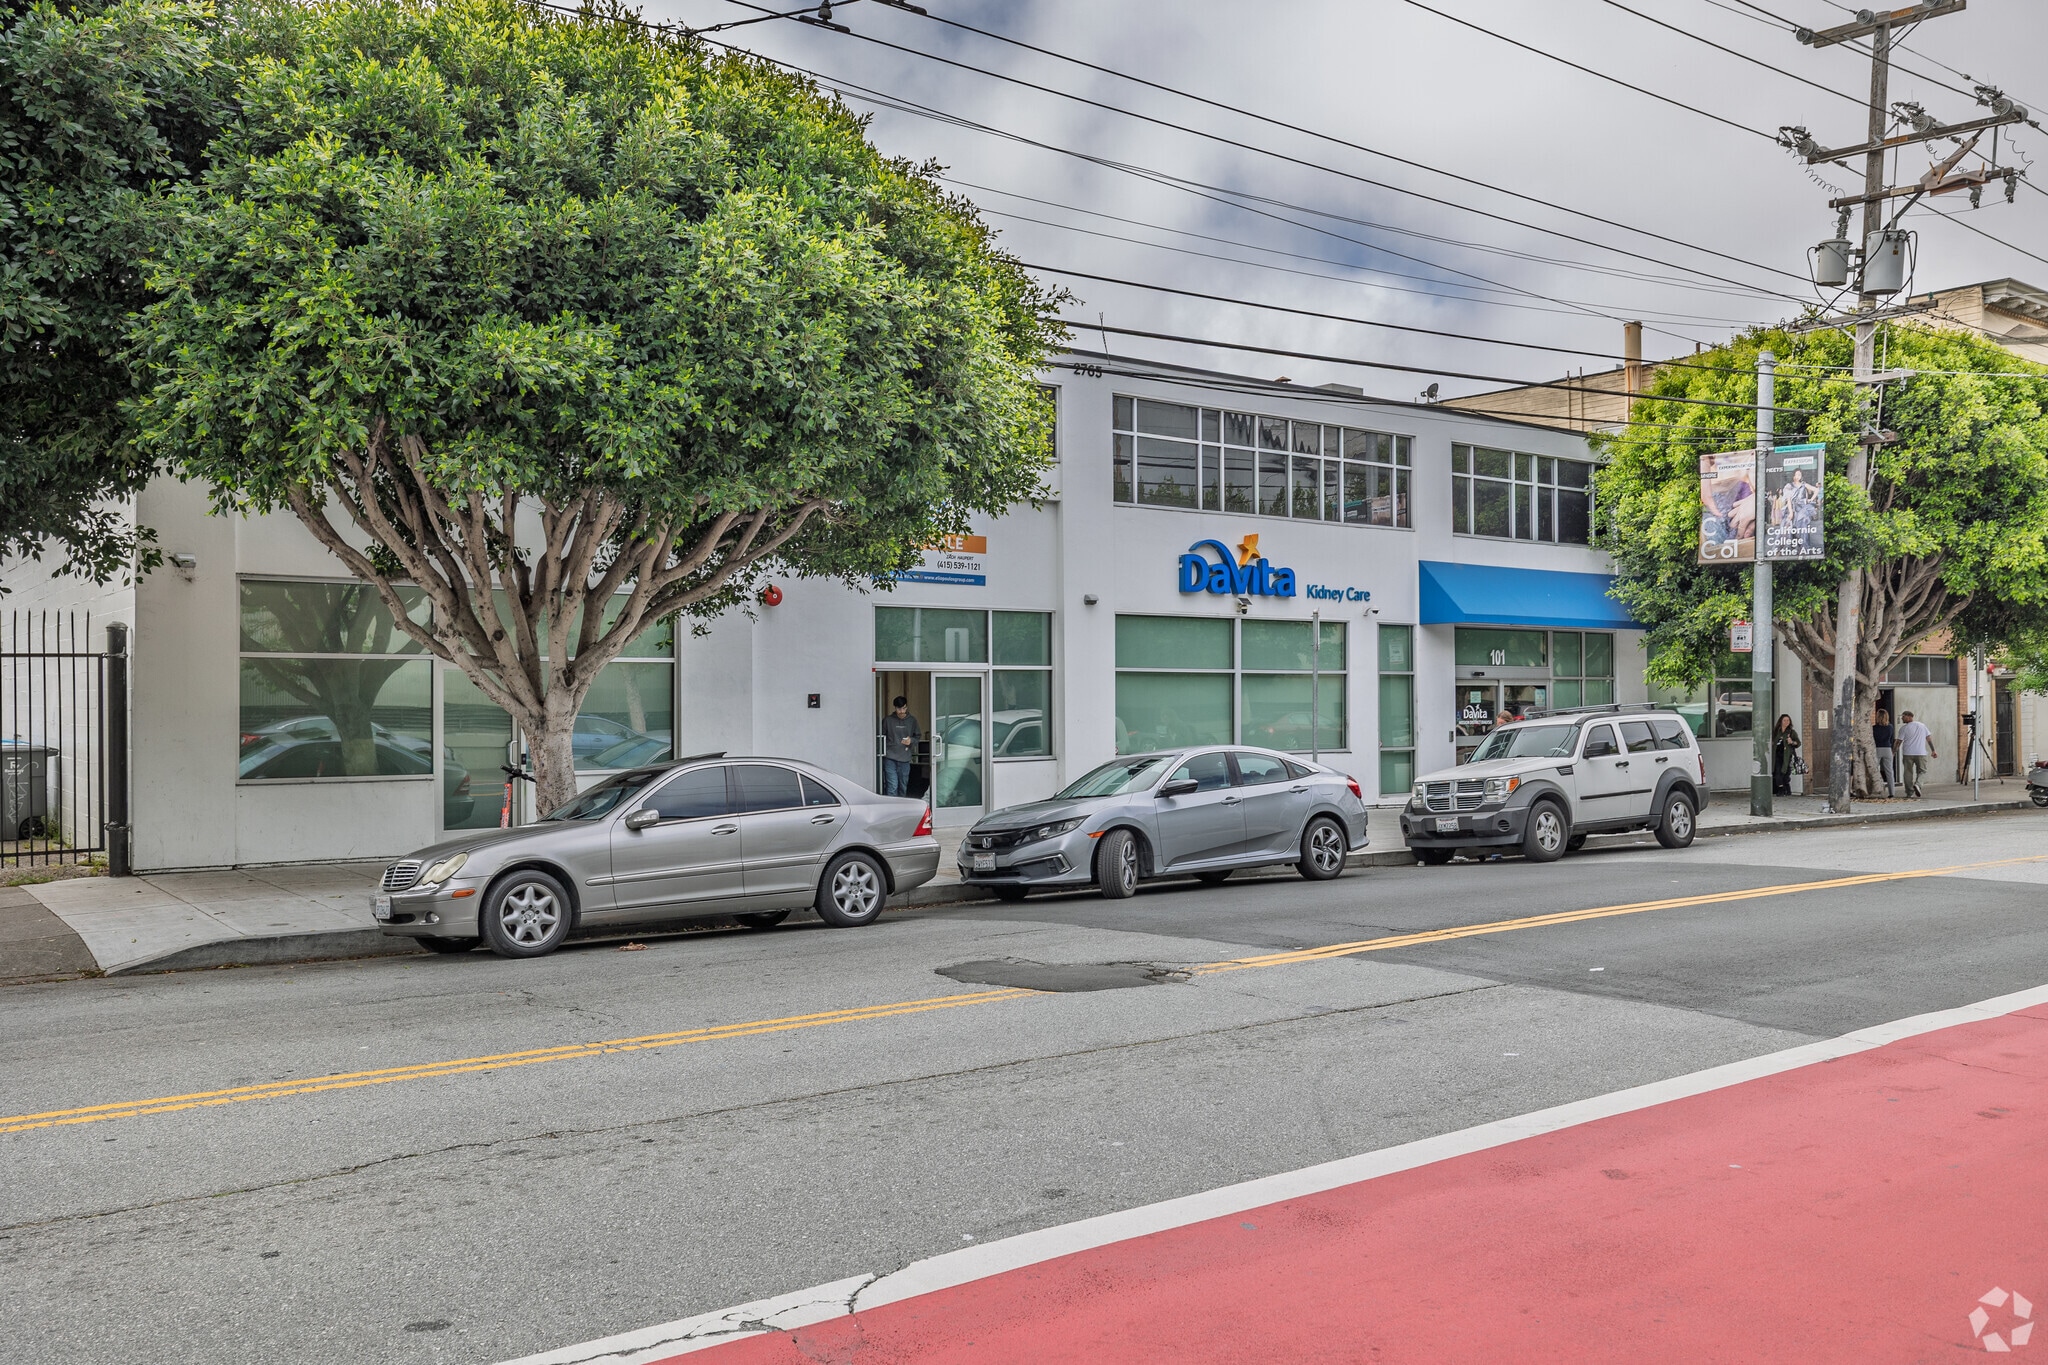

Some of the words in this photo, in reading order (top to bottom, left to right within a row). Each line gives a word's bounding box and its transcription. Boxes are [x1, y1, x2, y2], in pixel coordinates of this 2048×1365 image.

[1073, 362, 1103, 379] 2765
[1766, 525, 1817, 536] California
[1766, 537, 1804, 548] College
[1766, 549, 1778, 557] of
[1780, 547, 1798, 556] the
[1799, 546, 1822, 555] Arts
[937, 560, 953, 570] (415)
[953, 561, 981, 571] 539-1121
[1178, 540, 1297, 598] DaVita
[1306, 584, 1344, 603] Kidney
[1345, 587, 1371, 602] Care
[1490, 649, 1505, 665] 101
[1463, 705, 1488, 719] DaVita
